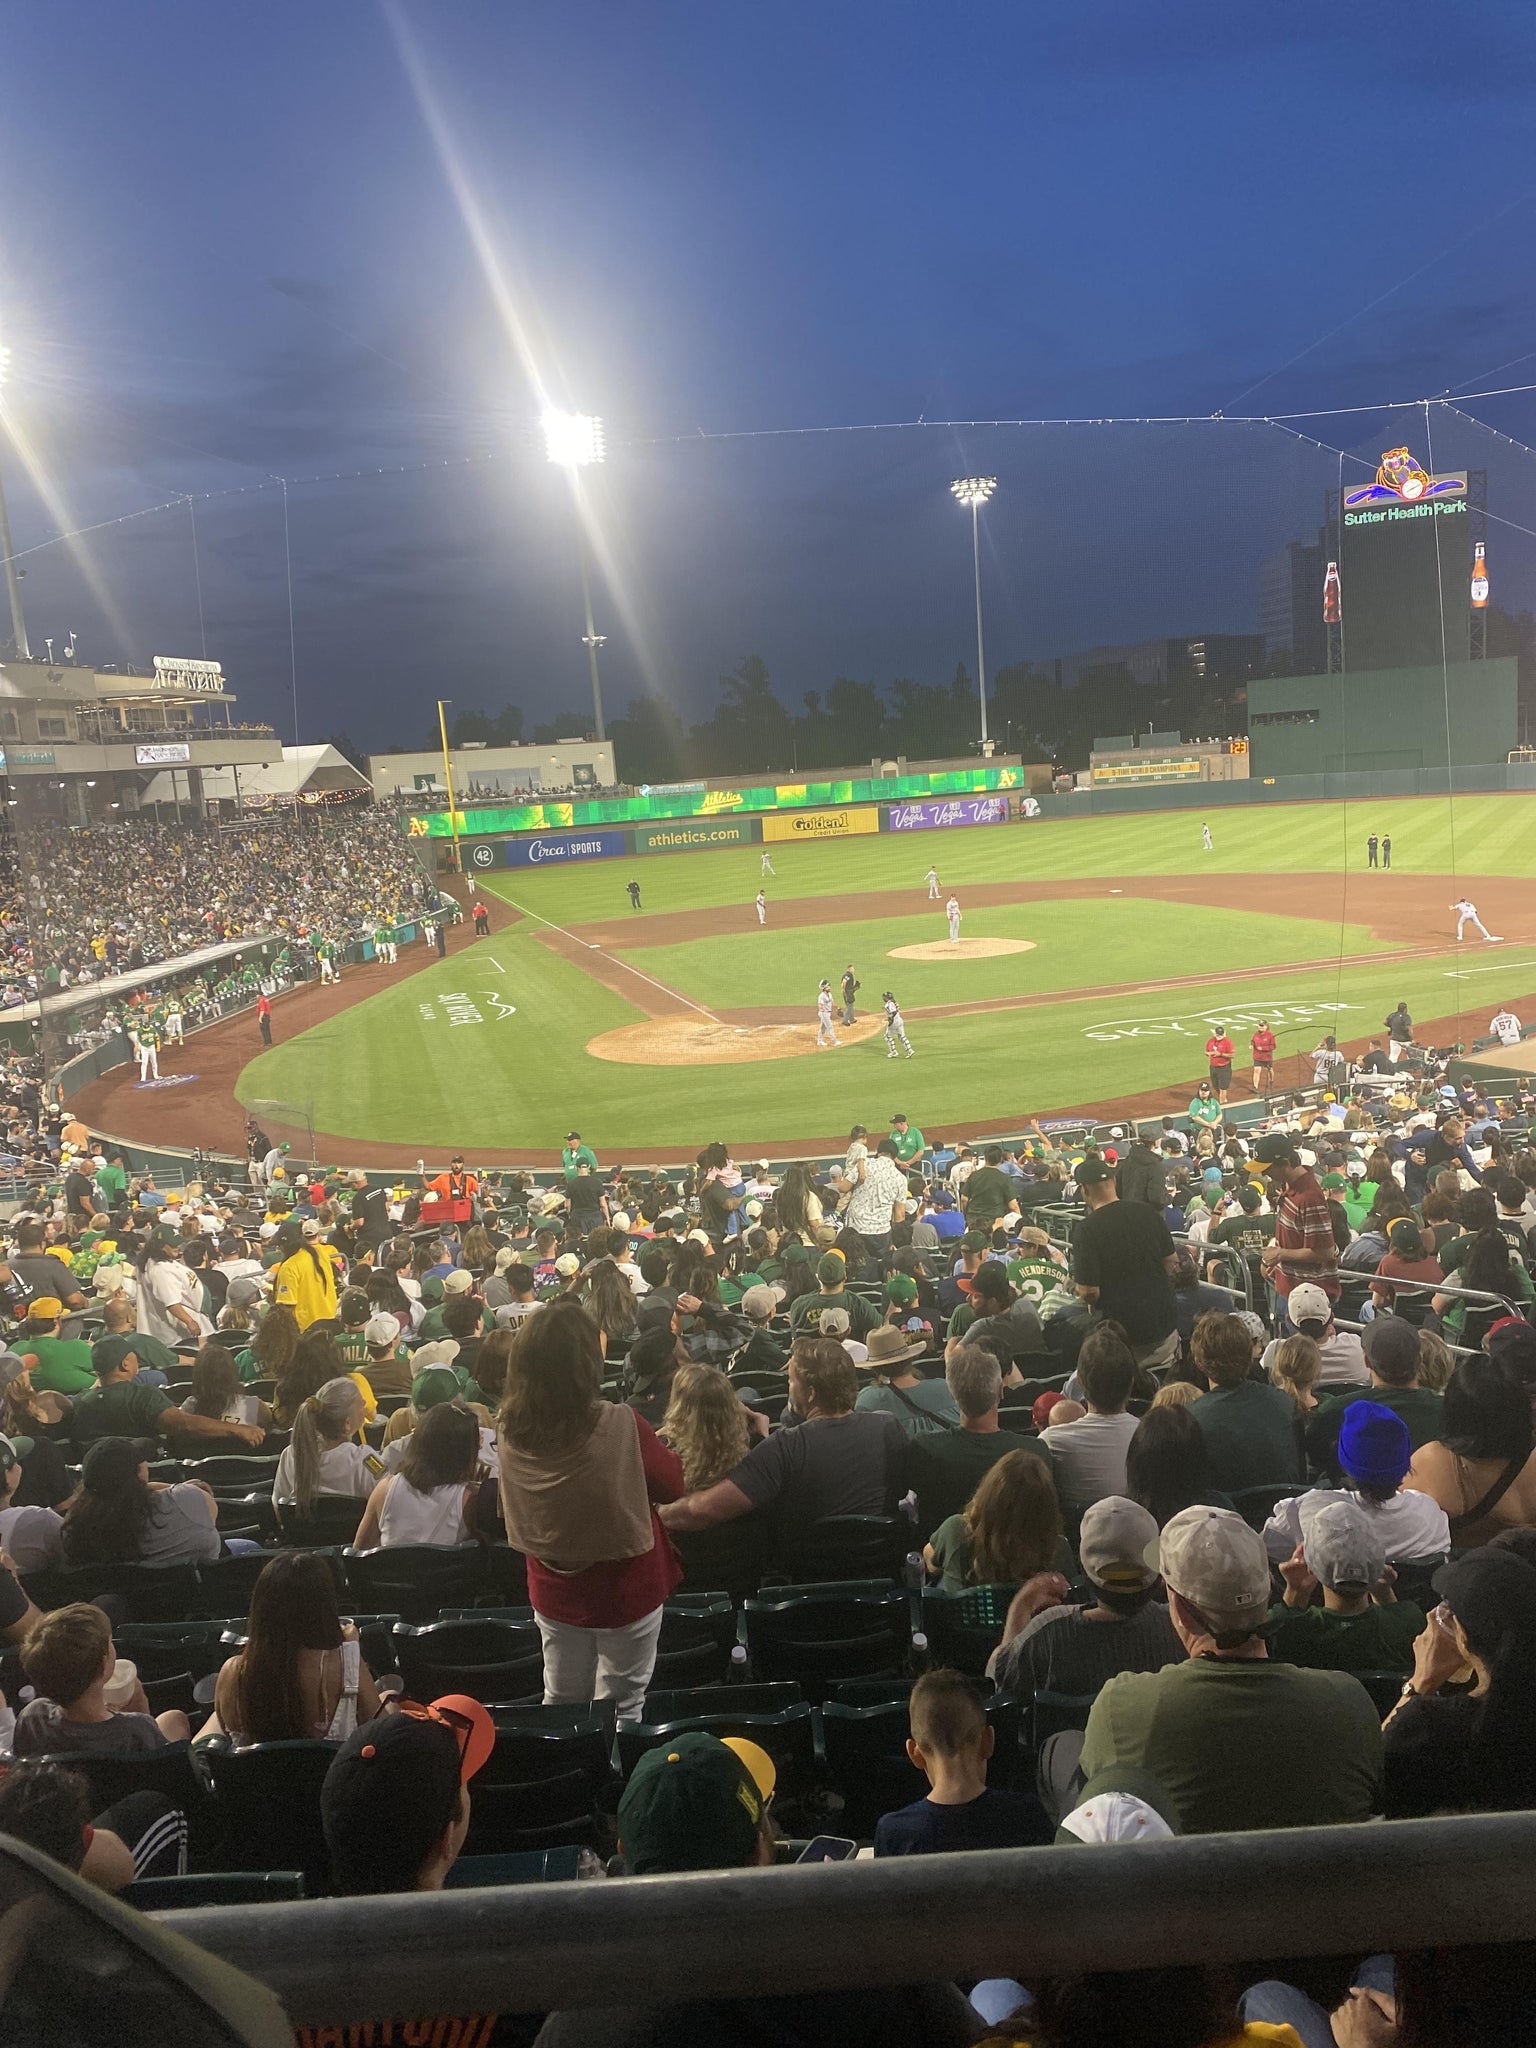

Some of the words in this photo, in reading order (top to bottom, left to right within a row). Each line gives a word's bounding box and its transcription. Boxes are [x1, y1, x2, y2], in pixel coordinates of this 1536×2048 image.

[1344, 511, 1387, 526] Sutter
[1388, 504, 1433, 520] Health
[1433, 500, 1467, 515] Park
[701, 791, 743, 810] Athletics
[891, 808, 928, 828] Vegas
[929, 803, 967, 825] Vegas
[968, 801, 1002, 823] Vega
[407, 817, 430, 837] A's
[648, 829, 740, 847] athletics.com
[477, 850, 490, 862] 42
[528, 840, 566, 862] Circa
[571, 841, 602, 855] SPORTS
[1085, 1022, 1185, 1041] SKY
[1202, 1002, 1366, 1026] RIVER
[1499, 1020, 1512, 1031] 57
[1019, 1265, 1065, 1282] HENDERSON
